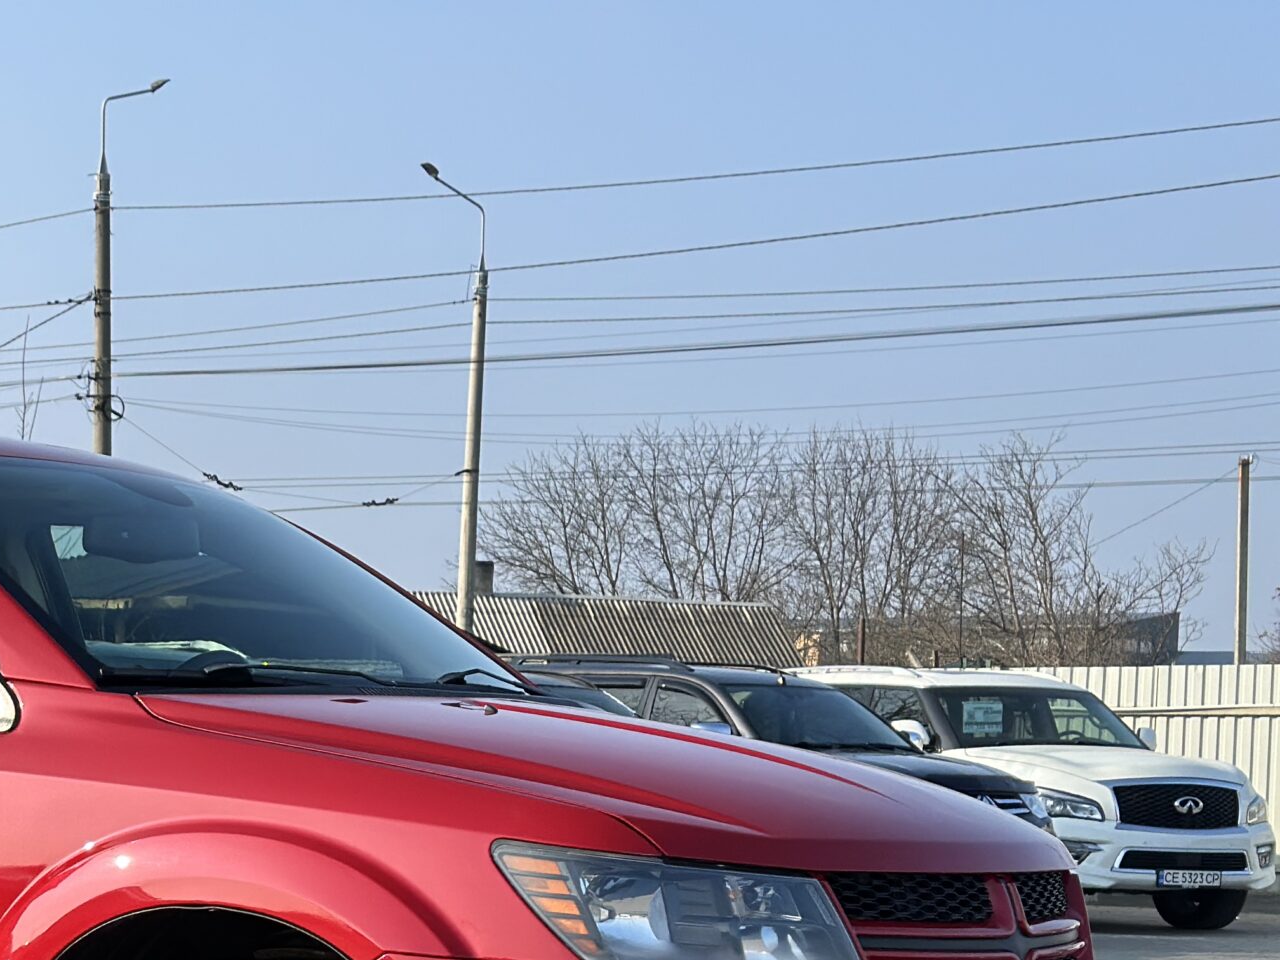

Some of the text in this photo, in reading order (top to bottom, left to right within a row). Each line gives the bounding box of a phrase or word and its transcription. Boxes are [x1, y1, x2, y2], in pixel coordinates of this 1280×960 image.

[1165, 872, 1219, 884] CE 5323 CP
